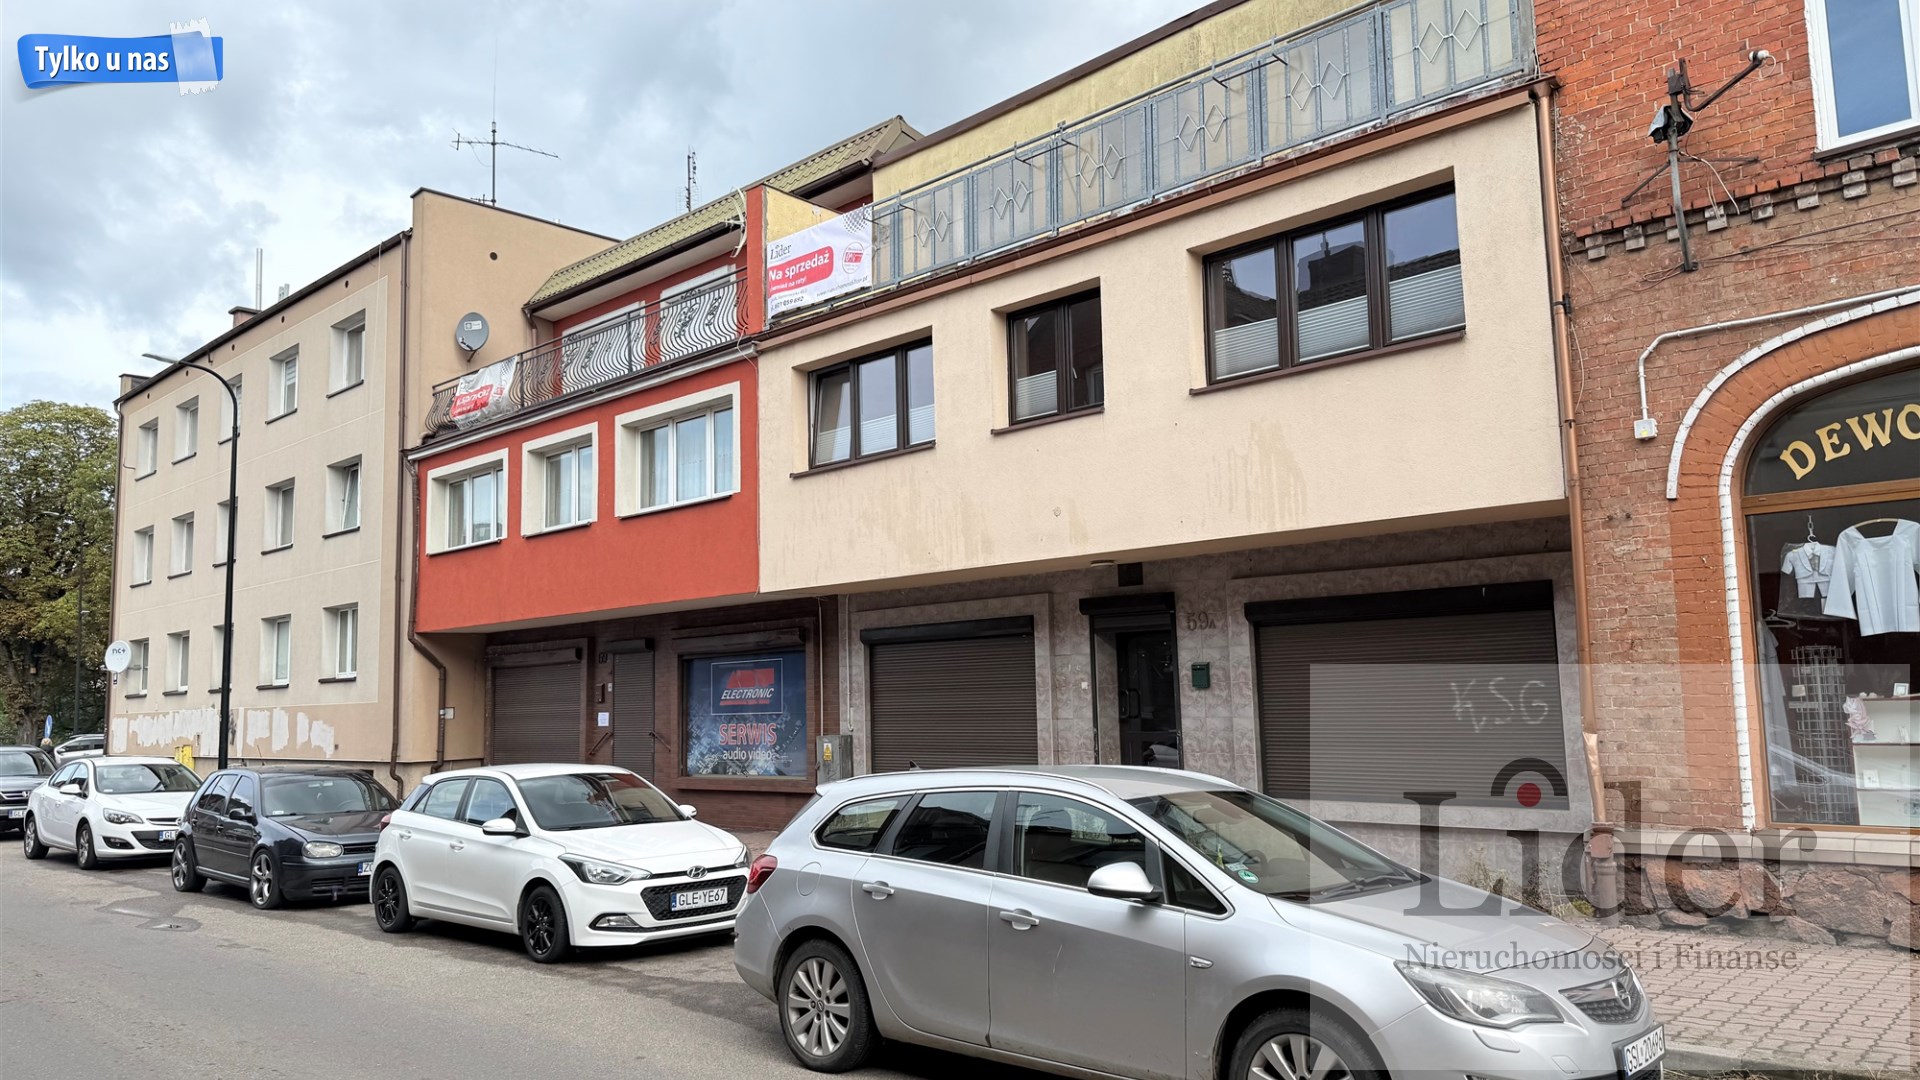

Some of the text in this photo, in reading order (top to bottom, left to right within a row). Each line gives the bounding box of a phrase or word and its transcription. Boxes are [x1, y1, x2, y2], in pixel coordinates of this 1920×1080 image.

[768, 250, 830, 281] Na sprzedaż
[721, 688, 774, 700] ELECTRONIC
[720, 723, 777, 746] SERWIS
[723, 747, 772, 760] audio video
[679, 888, 726, 906] GLE YE67
